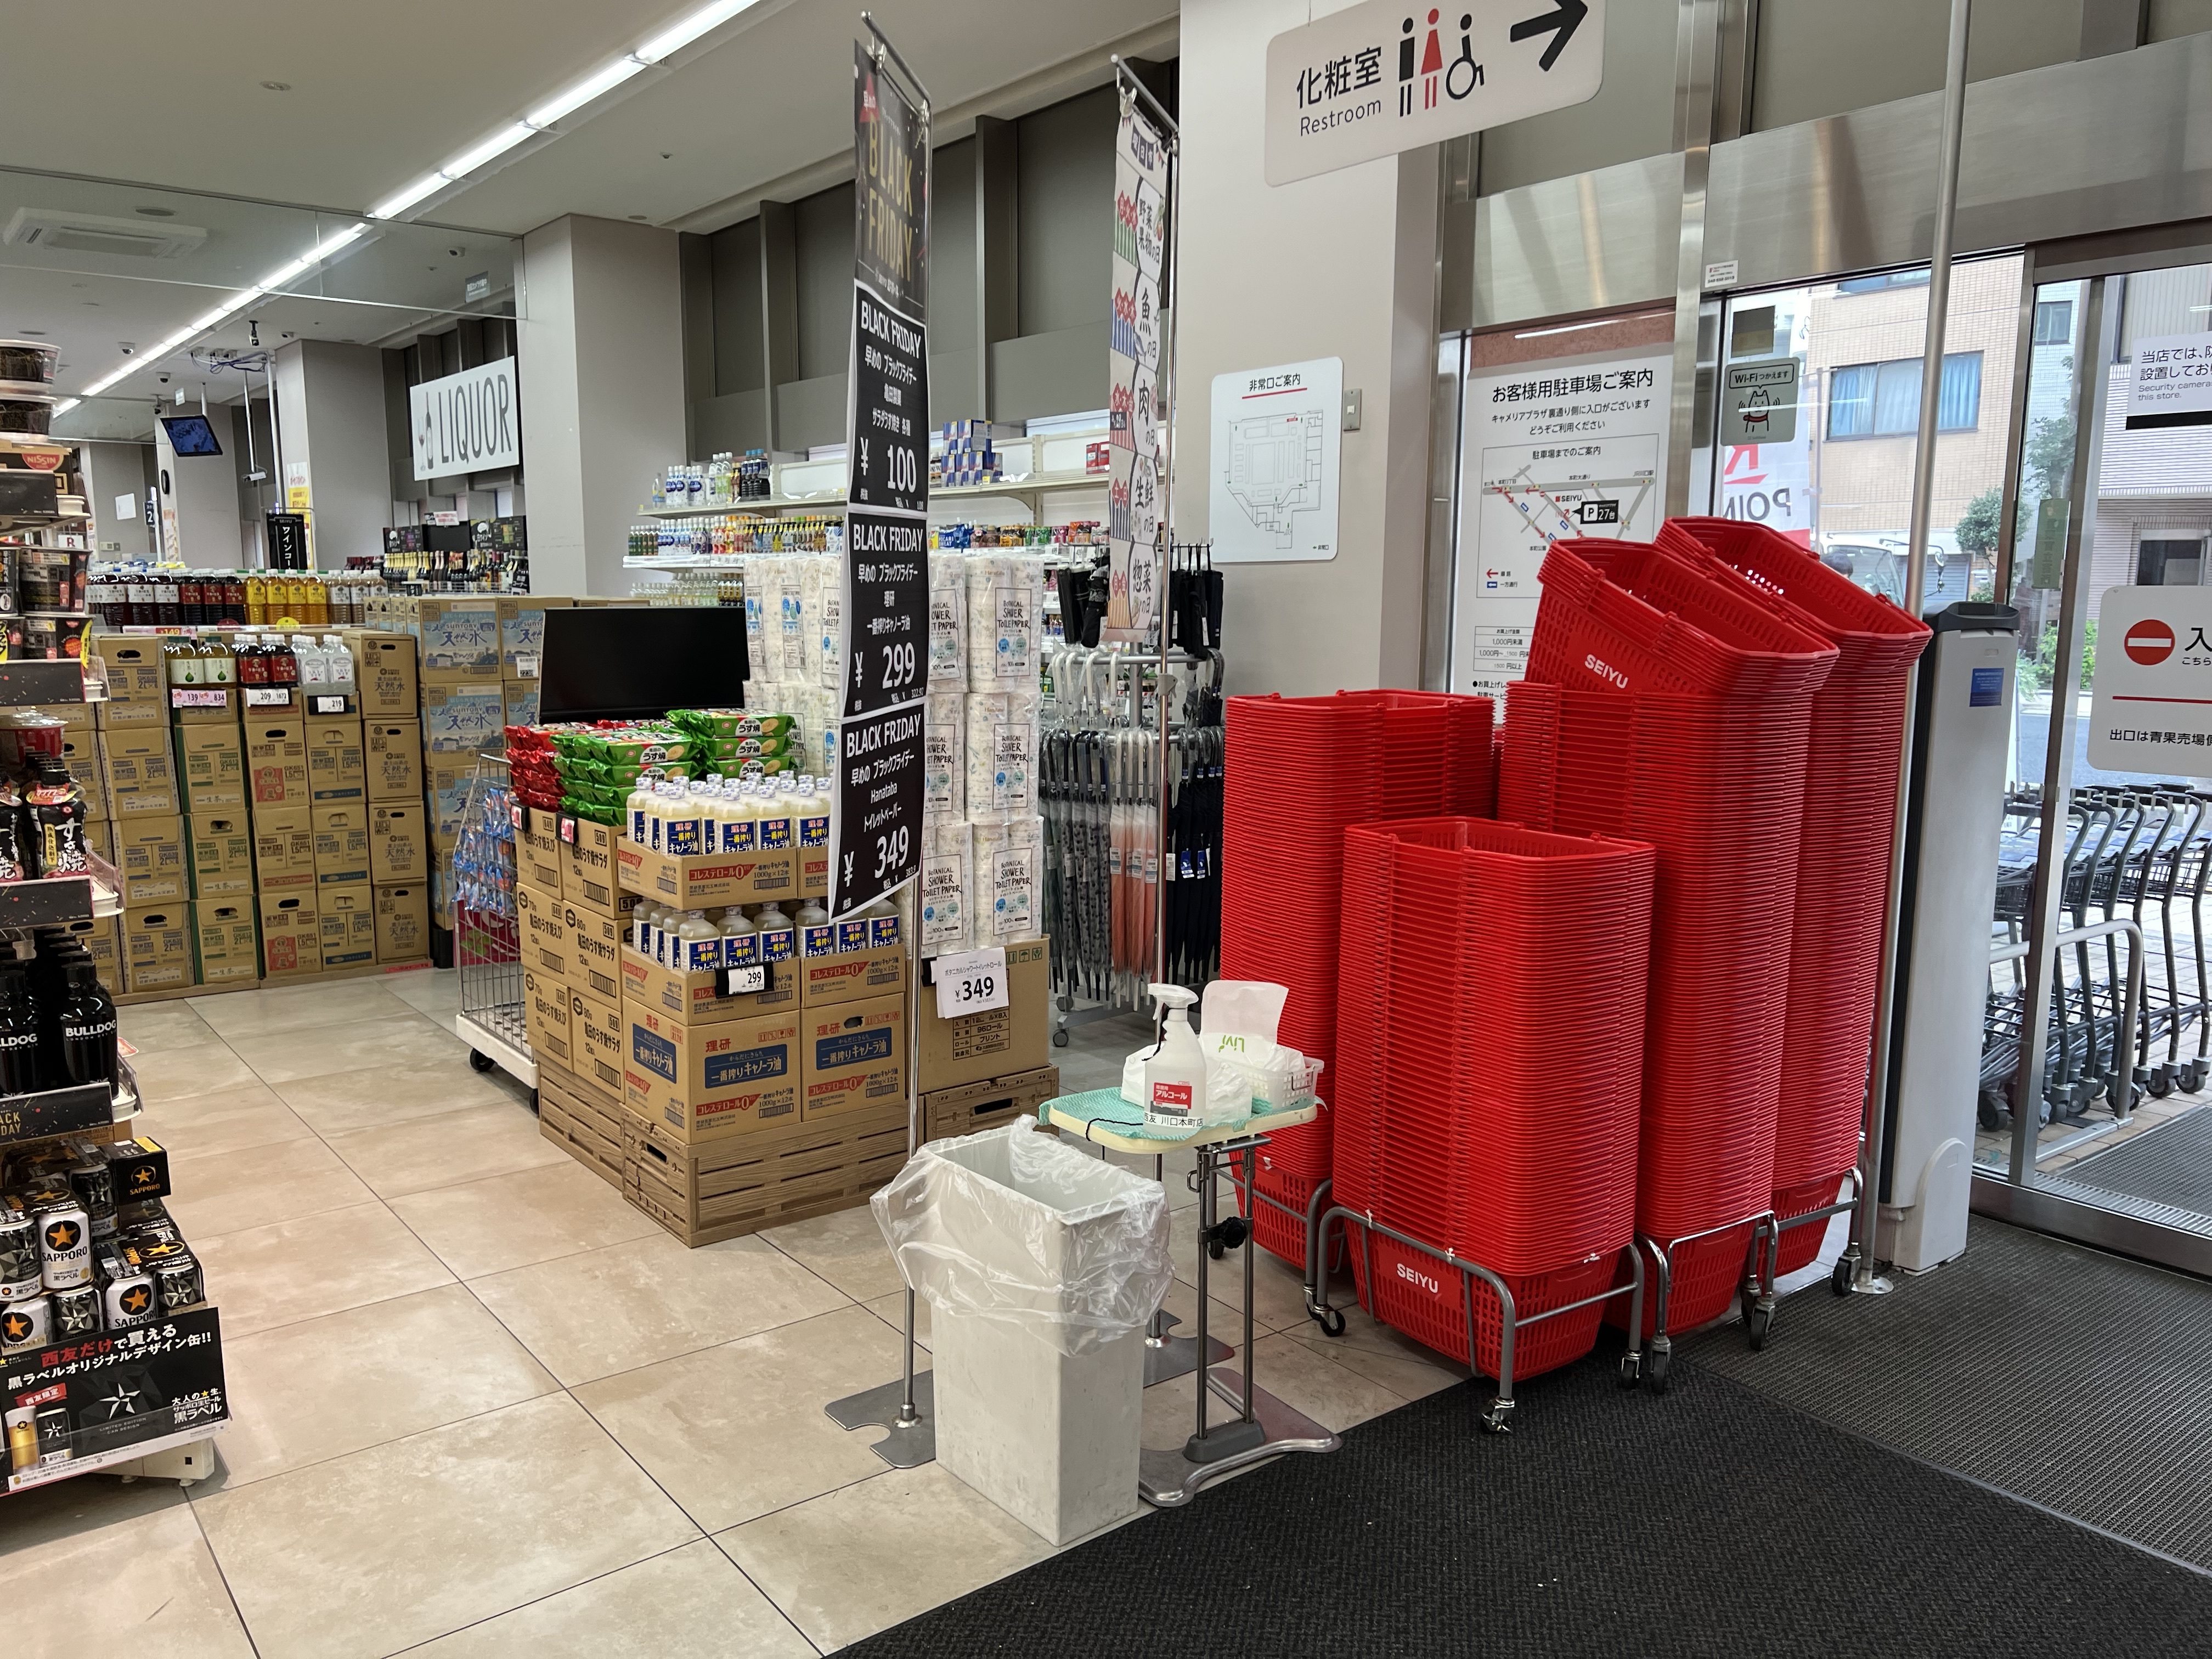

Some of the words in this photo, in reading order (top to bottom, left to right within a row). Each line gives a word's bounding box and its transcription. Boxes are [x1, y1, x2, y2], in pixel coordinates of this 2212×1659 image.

[1297, 47, 1381, 109] 化粧室
[1300, 99, 1381, 136] Restroom
[869, 115, 912, 217] BLACK
[1139, 198, 1152, 231] 野菜
[869, 187, 912, 282] FRIDAY
[1139, 287, 1152, 336] 魚
[861, 300, 890, 343] BLACK
[891, 319, 921, 359] FRIDAY
[865, 345, 882, 371] 早めの
[884, 353, 917, 385] ブラックフライデー
[2140, 364, 2212, 381] 設置してお
[1249, 374, 1300, 391] 非常口ご案内
[1492, 368, 1653, 403] お客様用駐車場ご案内
[2138, 382, 2175, 392] Security
[1138, 379, 1150, 427] 肉
[438, 374, 512, 465] LIQUOR
[1530, 421, 1605, 435] どうぞご利用ください
[1146, 429, 1155, 446] の日
[27, 454, 56, 465] NISSIN
[1532, 447, 1601, 459] 駐車場までのご案内
[887, 444, 916, 493] 100
[1135, 476, 1154, 510] 生鮮
[1588, 507, 1594, 517] P
[1143, 515, 1154, 534] の日
[854, 524, 887, 551] BLACK
[889, 527, 923, 552] FRIDAY
[283, 526, 292, 569] ワインコー
[858, 563, 876, 583] 早めの
[879, 563, 918, 583] ブラックフライデー
[1132, 558, 1152, 594] 惣菜
[1140, 596, 1150, 614] の日
[439, 630, 487, 646] 天然水
[882, 642, 915, 689] 299
[1584, 654, 1628, 689] SEIYU
[375, 684, 405, 692] 天然水
[445, 714, 493, 730] 天然水
[847, 724, 881, 758] BLACK
[884, 713, 921, 744] FRIDAY
[851, 768, 870, 787] 早めの
[873, 748, 915, 780] ブラックフライデー
[934, 755, 953, 764] PAPER
[871, 781, 898, 804] Hanataba
[671, 832, 696, 842] 一番搾り
[727, 833, 751, 843] 一番搾り
[764, 830, 788, 840] 一番搾り
[55, 817, 87, 873] すき焼
[669, 840, 698, 854] キャノーラ油
[724, 842, 754, 853] キャノーラ油
[762, 839, 790, 849] キャノーラ油
[874, 825, 909, 879] 349
[928, 867, 953, 876] BOTANICAL
[1001, 860, 1024, 868] BOTANICAL
[928, 874, 954, 887] SHOWER
[1001, 867, 1024, 879] SHOWER
[923, 887, 940, 898] TOILET
[941, 884, 962, 896] PAPER
[995, 879, 1011, 889] TOILET
[1012, 877, 1031, 886] PAPER
[748, 972, 761, 984] 299
[962, 976, 994, 1001] 349
[65, 1019, 116, 1037] BULLDOG
[646, 1014, 658, 1031] 理研
[817, 1023, 841, 1036] 理研
[977, 1023, 1003, 1033] 96ロール
[706, 1039, 731, 1052] 理研
[980, 1033, 1000, 1042] プリント
[822, 1041, 887, 1064] 一番搾りキャノーラ油
[712, 1056, 782, 1082] 一番搾りキャノーラ油
[1156, 1090, 1187, 1099] アルコール
[1161, 1116, 1203, 1127] 川口本町店
[129, 1184, 160, 1195] SAPPORO
[42, 1246, 87, 1262] SAPPORO
[1397, 1263, 1438, 1293] SEIYU
[41, 1323, 177, 1368] 西友だけで買える
[8, 1331, 211, 1390] 黒ラベルオリジナルデザイン缶!!
[172, 1392, 200, 1406] 大人の
[174, 1403, 222, 1424] 黒ラベル
